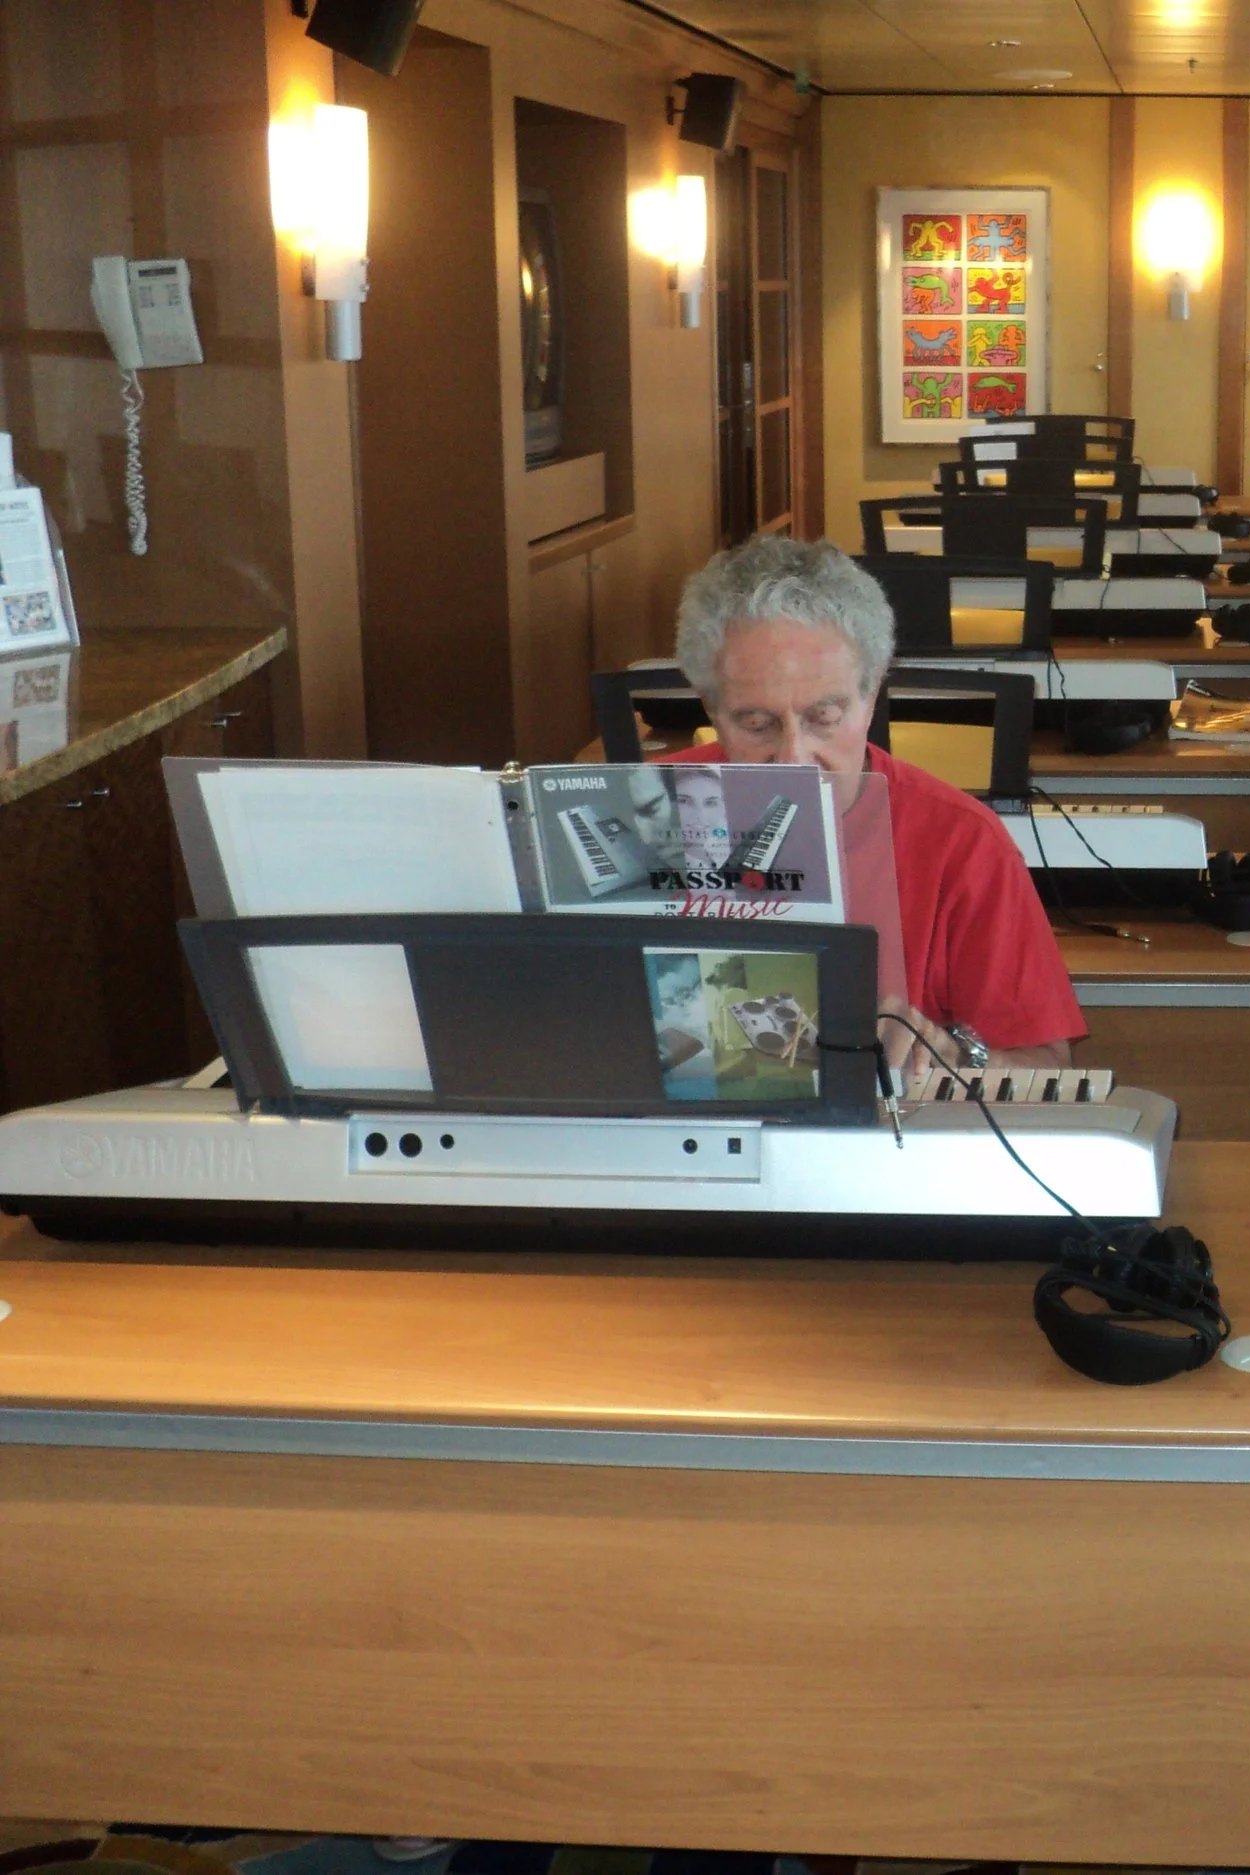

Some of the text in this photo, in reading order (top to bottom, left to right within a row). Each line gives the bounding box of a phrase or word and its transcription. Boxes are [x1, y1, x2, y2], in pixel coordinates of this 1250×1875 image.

[557, 777, 608, 791] YAMAHA
[648, 870, 805, 892] PASSPORT
[671, 890, 793, 919] Music
